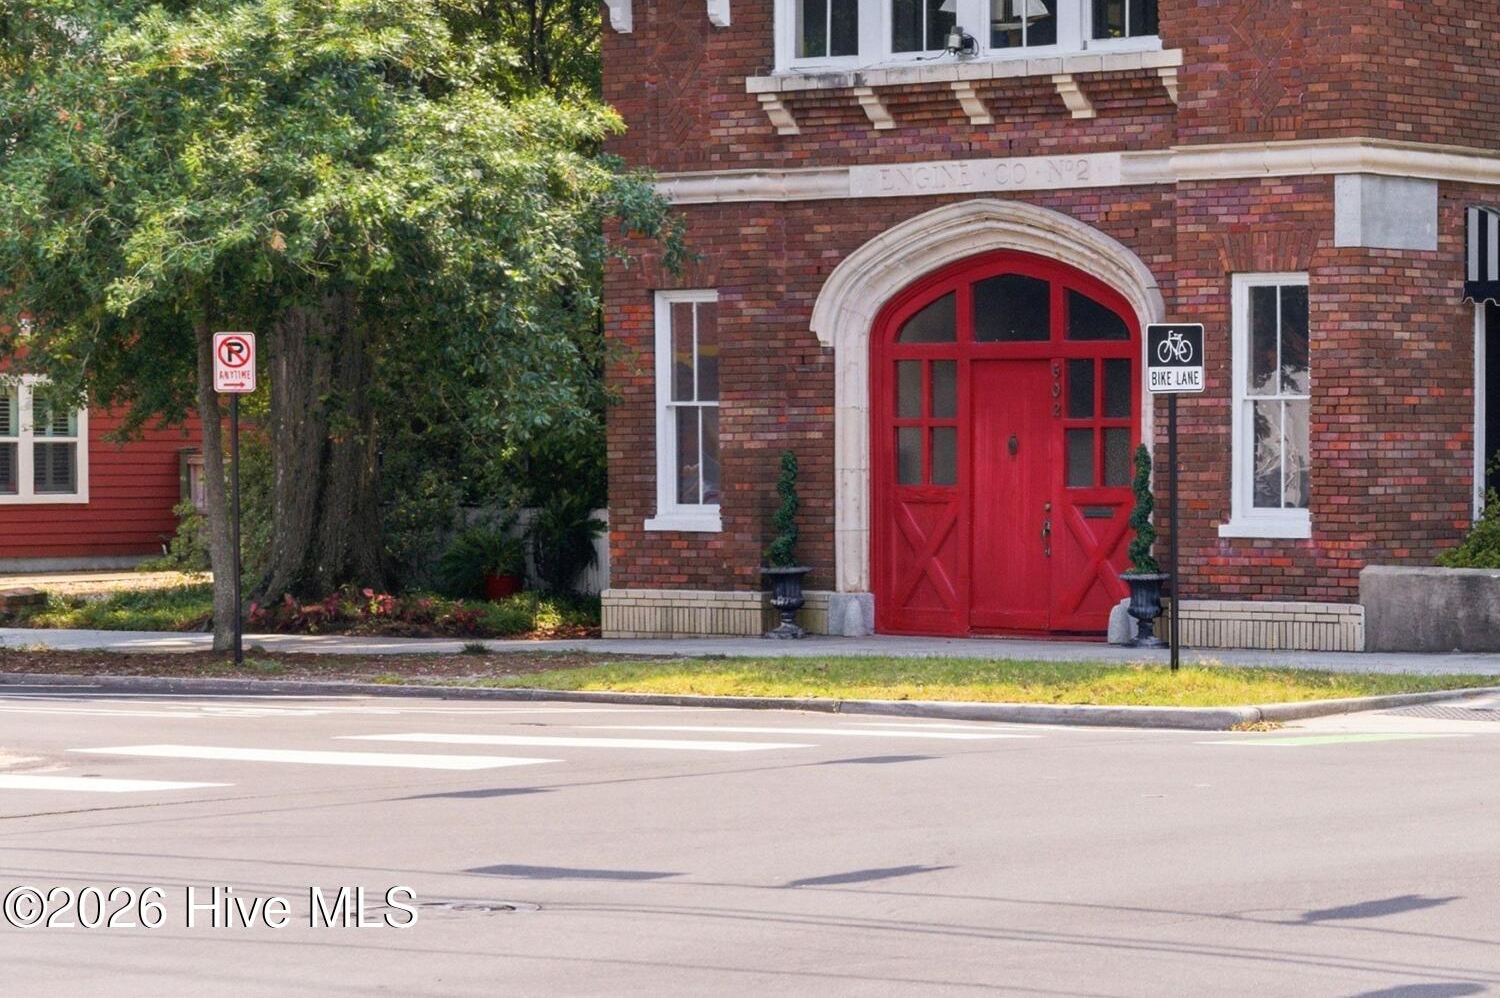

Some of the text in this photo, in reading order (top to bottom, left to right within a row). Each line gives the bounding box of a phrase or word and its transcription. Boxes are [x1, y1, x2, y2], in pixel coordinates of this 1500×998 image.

[880, 164, 972, 191] ENGINE
[995, 162, 1027, 185] CO
[219, 369, 251, 380] ANYTIME
[1151, 371, 1200, 386] BIKE LANE
